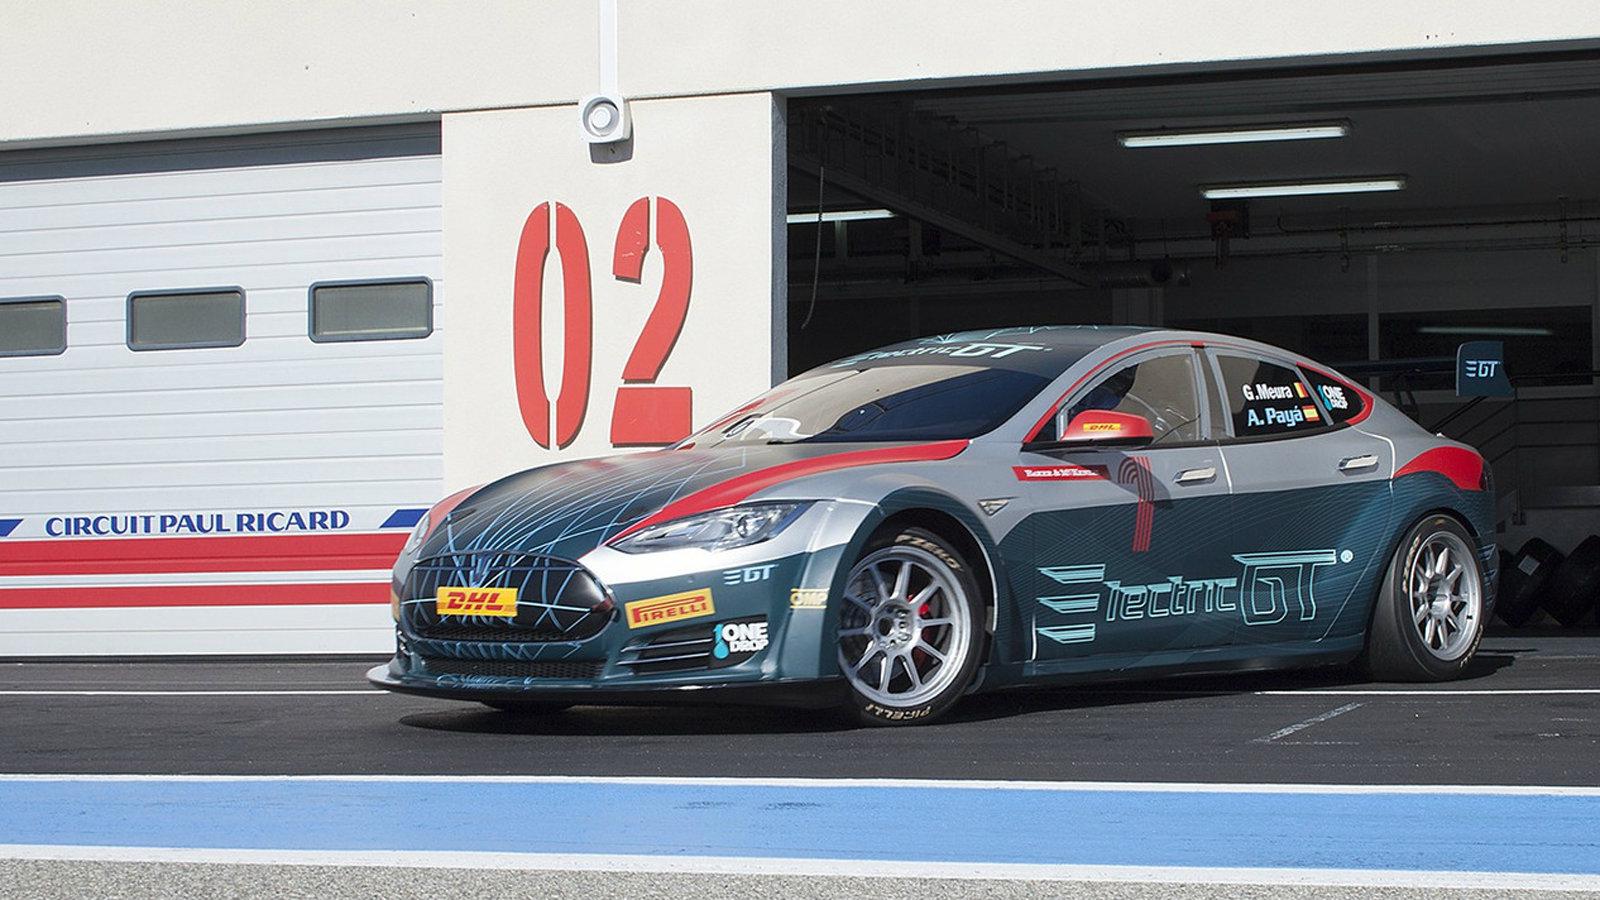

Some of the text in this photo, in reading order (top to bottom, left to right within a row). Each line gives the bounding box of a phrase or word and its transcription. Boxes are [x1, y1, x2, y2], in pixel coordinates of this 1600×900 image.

[513, 196, 693, 449] 02
[1322, 385, 1344, 400] ONE
[1247, 405, 1304, 427] A. Payá
[45, 510, 350, 537] CIRCUIT PAUL RICARD
[447, 591, 503, 611] DHL
[790, 590, 828, 607] OMP
[632, 595, 708, 624] PIRELLI
[722, 622, 769, 642] ONE
[729, 639, 769, 653] DROP
